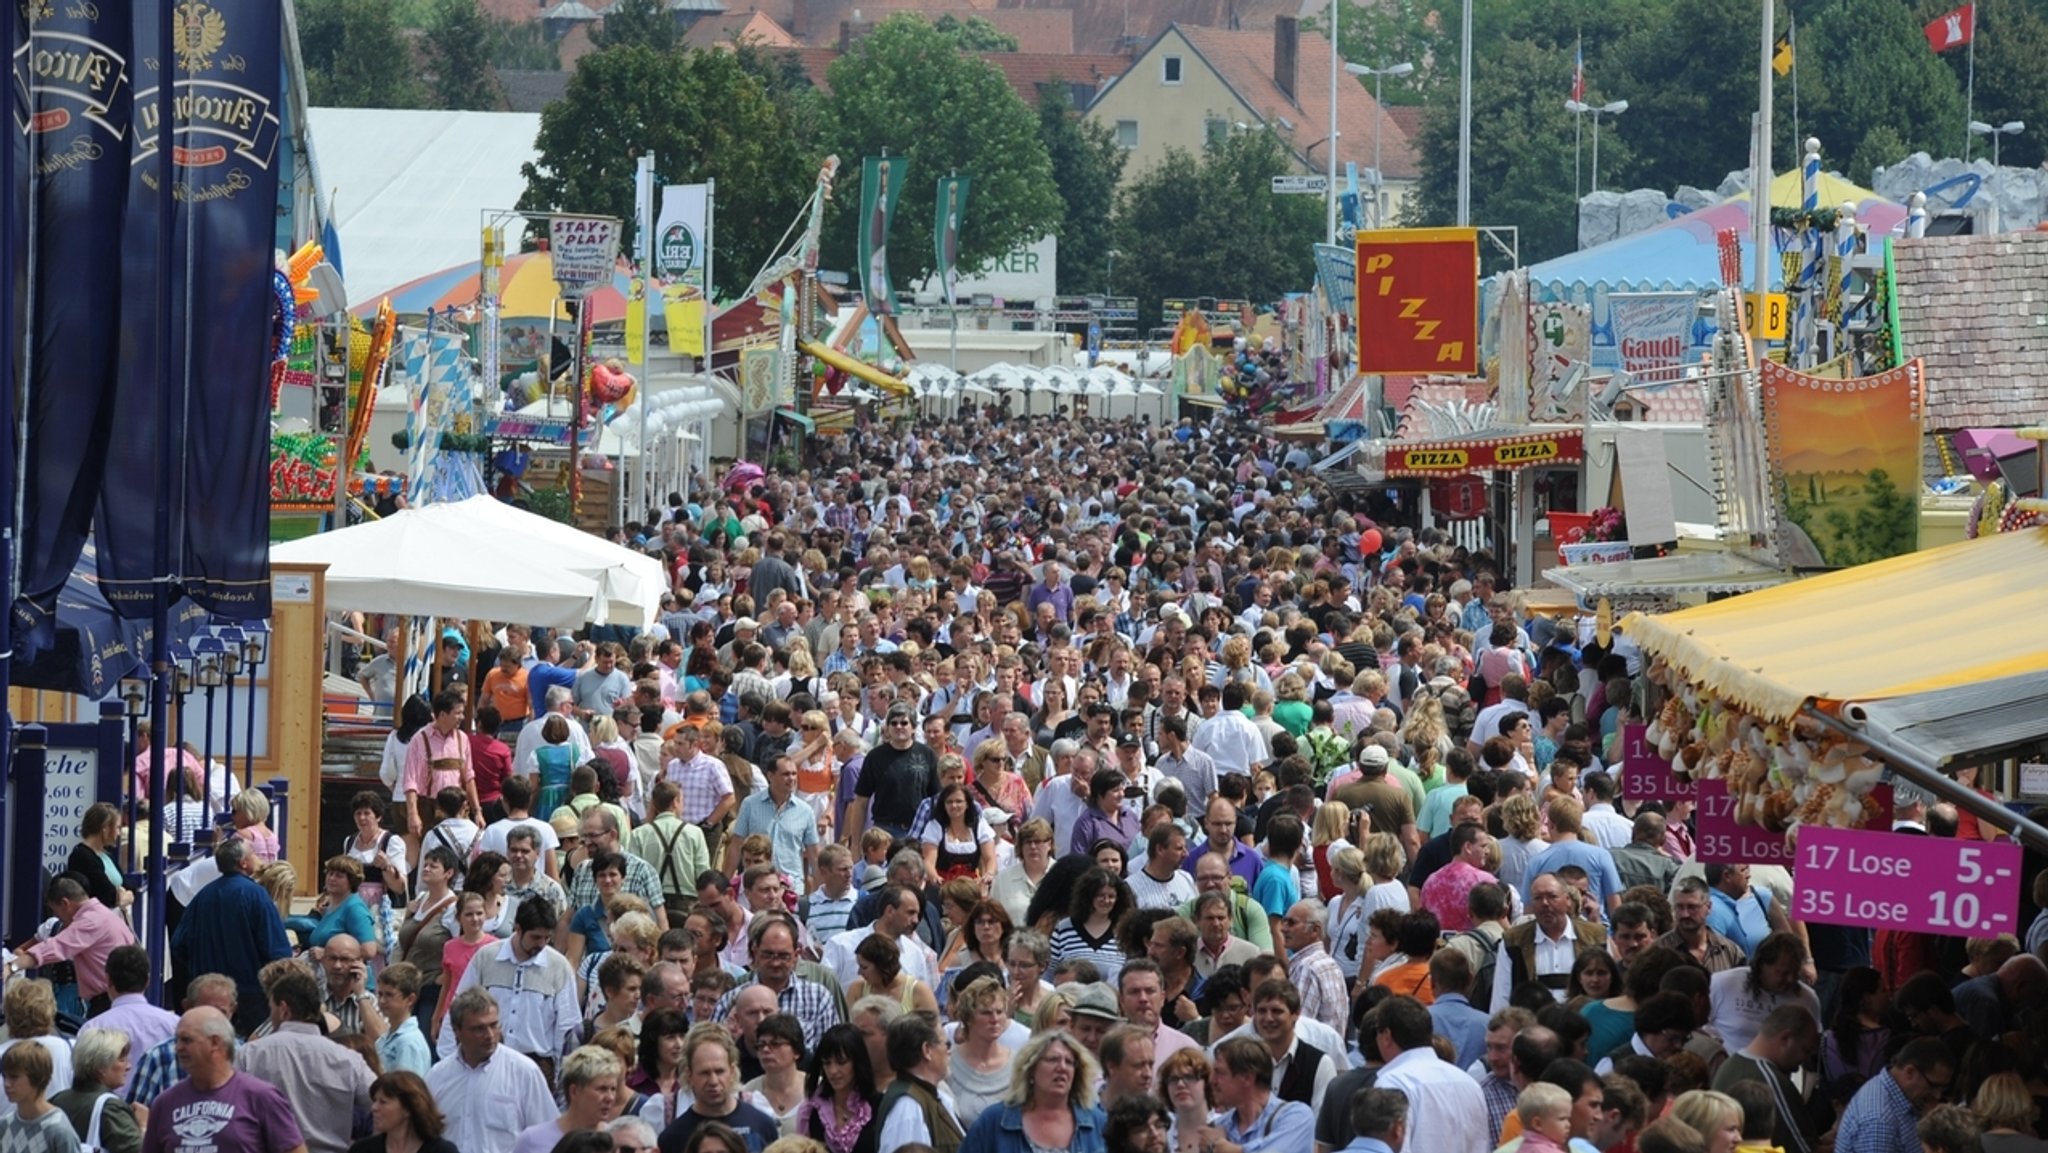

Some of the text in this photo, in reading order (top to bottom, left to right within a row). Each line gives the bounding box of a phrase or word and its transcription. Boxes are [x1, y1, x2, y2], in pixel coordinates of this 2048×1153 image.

[565, 234, 609, 246] PLAY
[980, 252, 1039, 274] CKER
[1365, 253, 1464, 363] PIZZA
[1770, 301, 1780, 331] B
[1621, 336, 1689, 359] Gaudi-
[1410, 453, 1462, 465] PIZZA
[1500, 443, 1553, 460] PIZZA
[1631, 740, 1653, 758] 1
[45, 754, 88, 775] che
[44, 785, 71, 800] ,60
[1630, 774, 1698, 795] 35 Los
[45, 804, 69, 818] ,90
[1704, 795, 1733, 817] 17
[44, 824, 69, 838] ,50
[43, 843, 67, 857] ,90
[1702, 834, 1732, 857] 35
[48, 862, 66, 874] 90
[1805, 844, 2012, 886] 17 Lose 5.-
[1800, 889, 2009, 931] 35 Lose 10.-
[172, 1100, 235, 1123] CALIFORNIA
